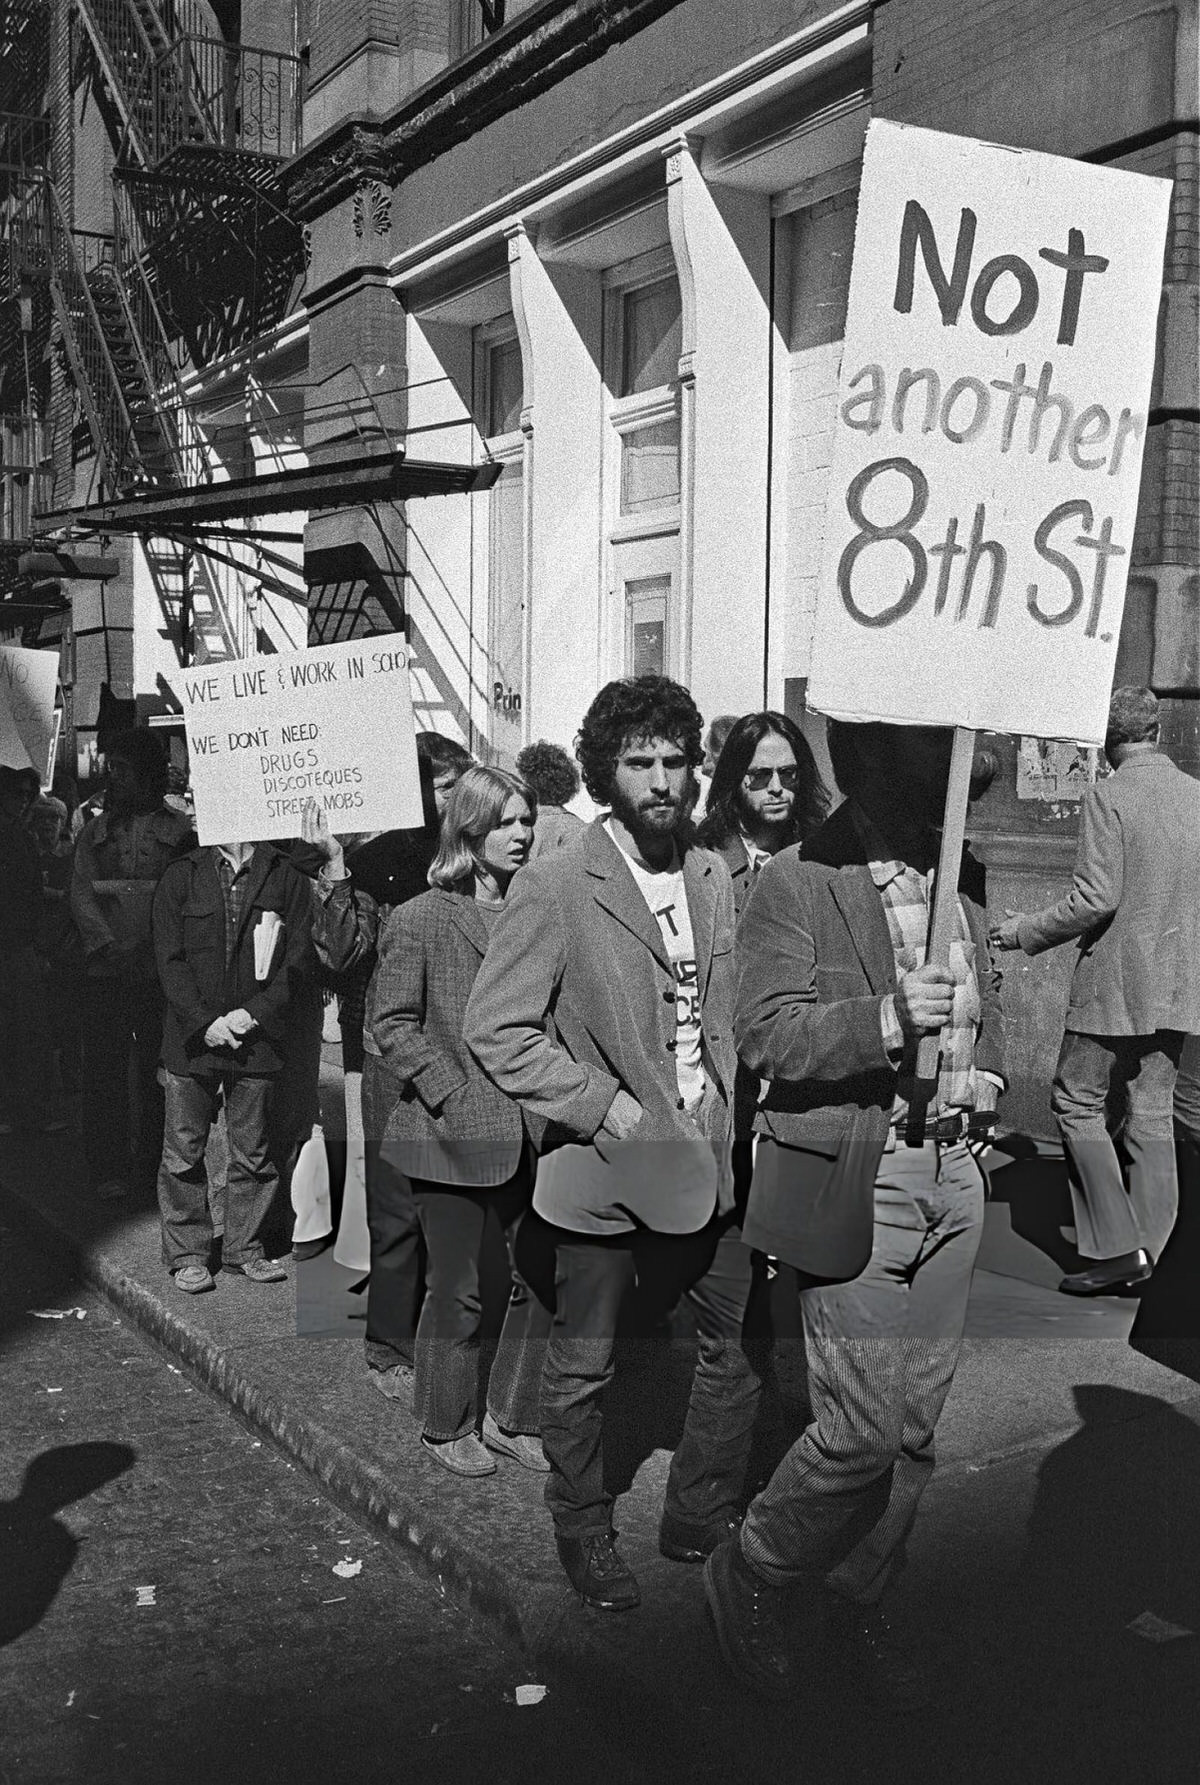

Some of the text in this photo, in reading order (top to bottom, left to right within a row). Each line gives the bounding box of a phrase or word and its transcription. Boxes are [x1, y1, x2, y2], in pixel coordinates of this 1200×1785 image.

[894, 200, 1109, 345] Not
[840, 361, 1146, 476] another
[837, 457, 1126, 642] 8th St.
[185, 678, 220, 704] WE
[233, 670, 267, 698] LIVE
[291, 661, 337, 687] WORK
[347, 657, 364, 679] IN
[192, 735, 219, 755] WE
[228, 727, 269, 751] DON'T
[260, 748, 318, 774] DRUGS
[264, 767, 362, 795] DISCOTEQUES
[323, 791, 364, 810] MOBS
